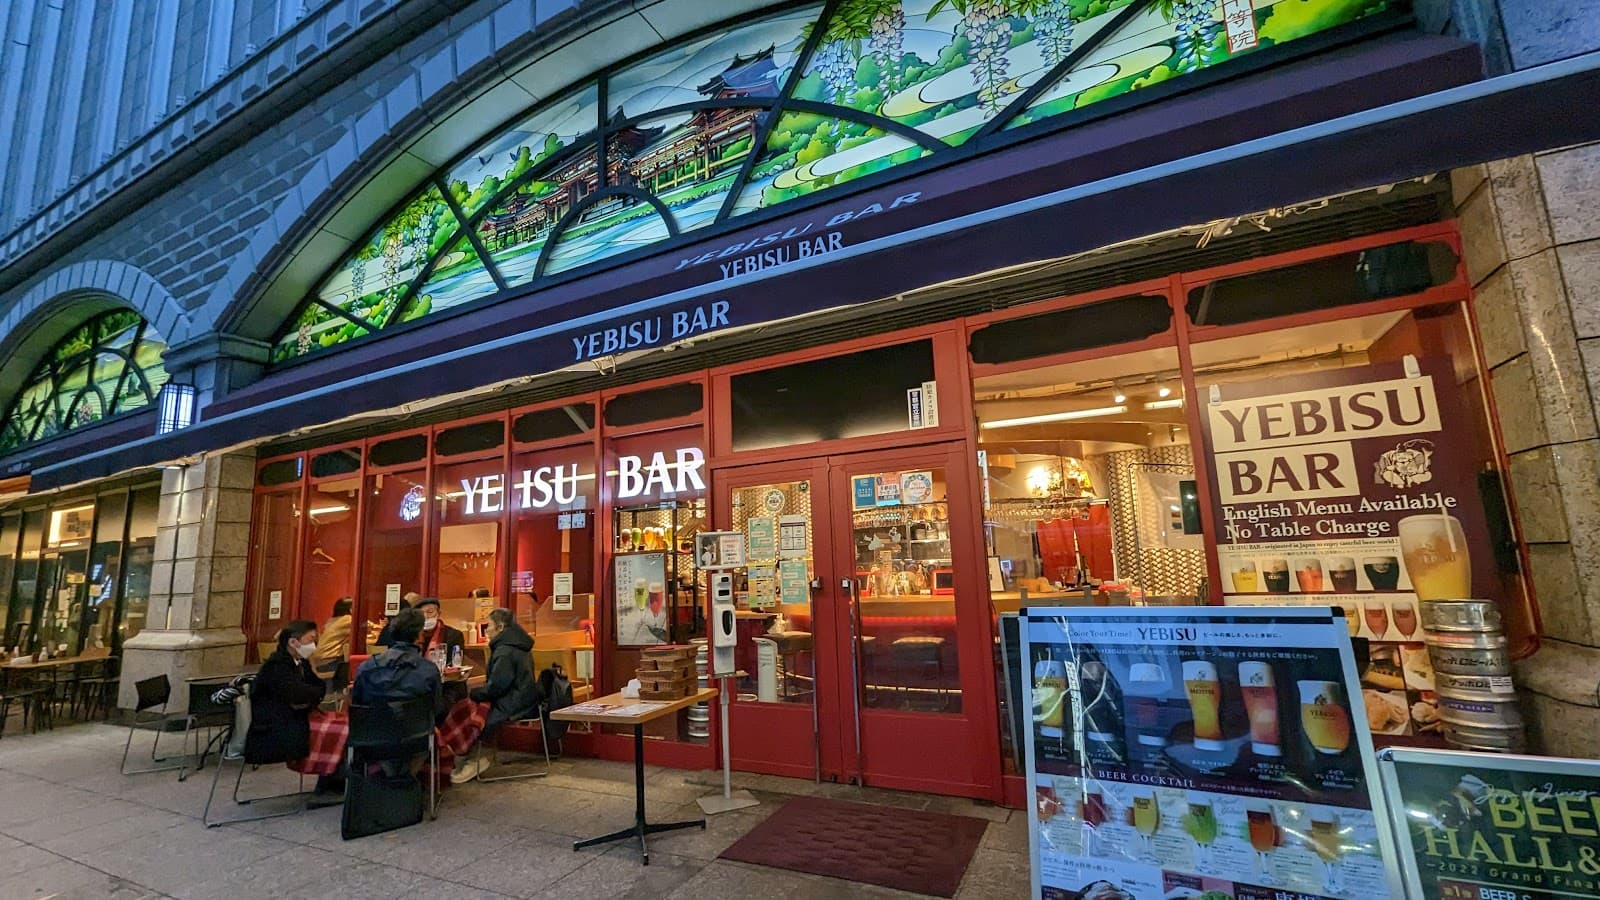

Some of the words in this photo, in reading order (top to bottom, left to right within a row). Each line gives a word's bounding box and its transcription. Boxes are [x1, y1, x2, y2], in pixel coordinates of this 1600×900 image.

[1225, 0, 1254, 50] 等院
[675, 222, 812, 271] YEBISU
[825, 190, 922, 228] BAR
[719, 249, 790, 282] YEBISU
[798, 231, 843, 261] BAR
[572, 317, 661, 361] YEBISU
[671, 300, 730, 339] BAR
[1219, 386, 1426, 443] YEBISU
[461, 463, 578, 515] YEISU
[617, 447, 706, 499] BAR
[1228, 452, 1345, 497] BAR
[1222, 503, 1292, 524] English
[1296, 501, 1353, 516] Menu
[1359, 492, 1457, 513] Available
[1224, 524, 1251, 540] No
[1255, 521, 1312, 537] Table
[1315, 517, 1390, 537] Charge
[1299, 541, 1316, 549] Japan
[1137, 627, 1197, 641] YEBISU
[1099, 770, 1127, 781] BEER
[1132, 773, 1196, 788] COCKTAIL
[1487, 788, 1600, 836] BEE
[1421, 825, 1574, 873] HALL
[1578, 846, 1600, 876] &
[1489, 868, 1542, 883] Grand
